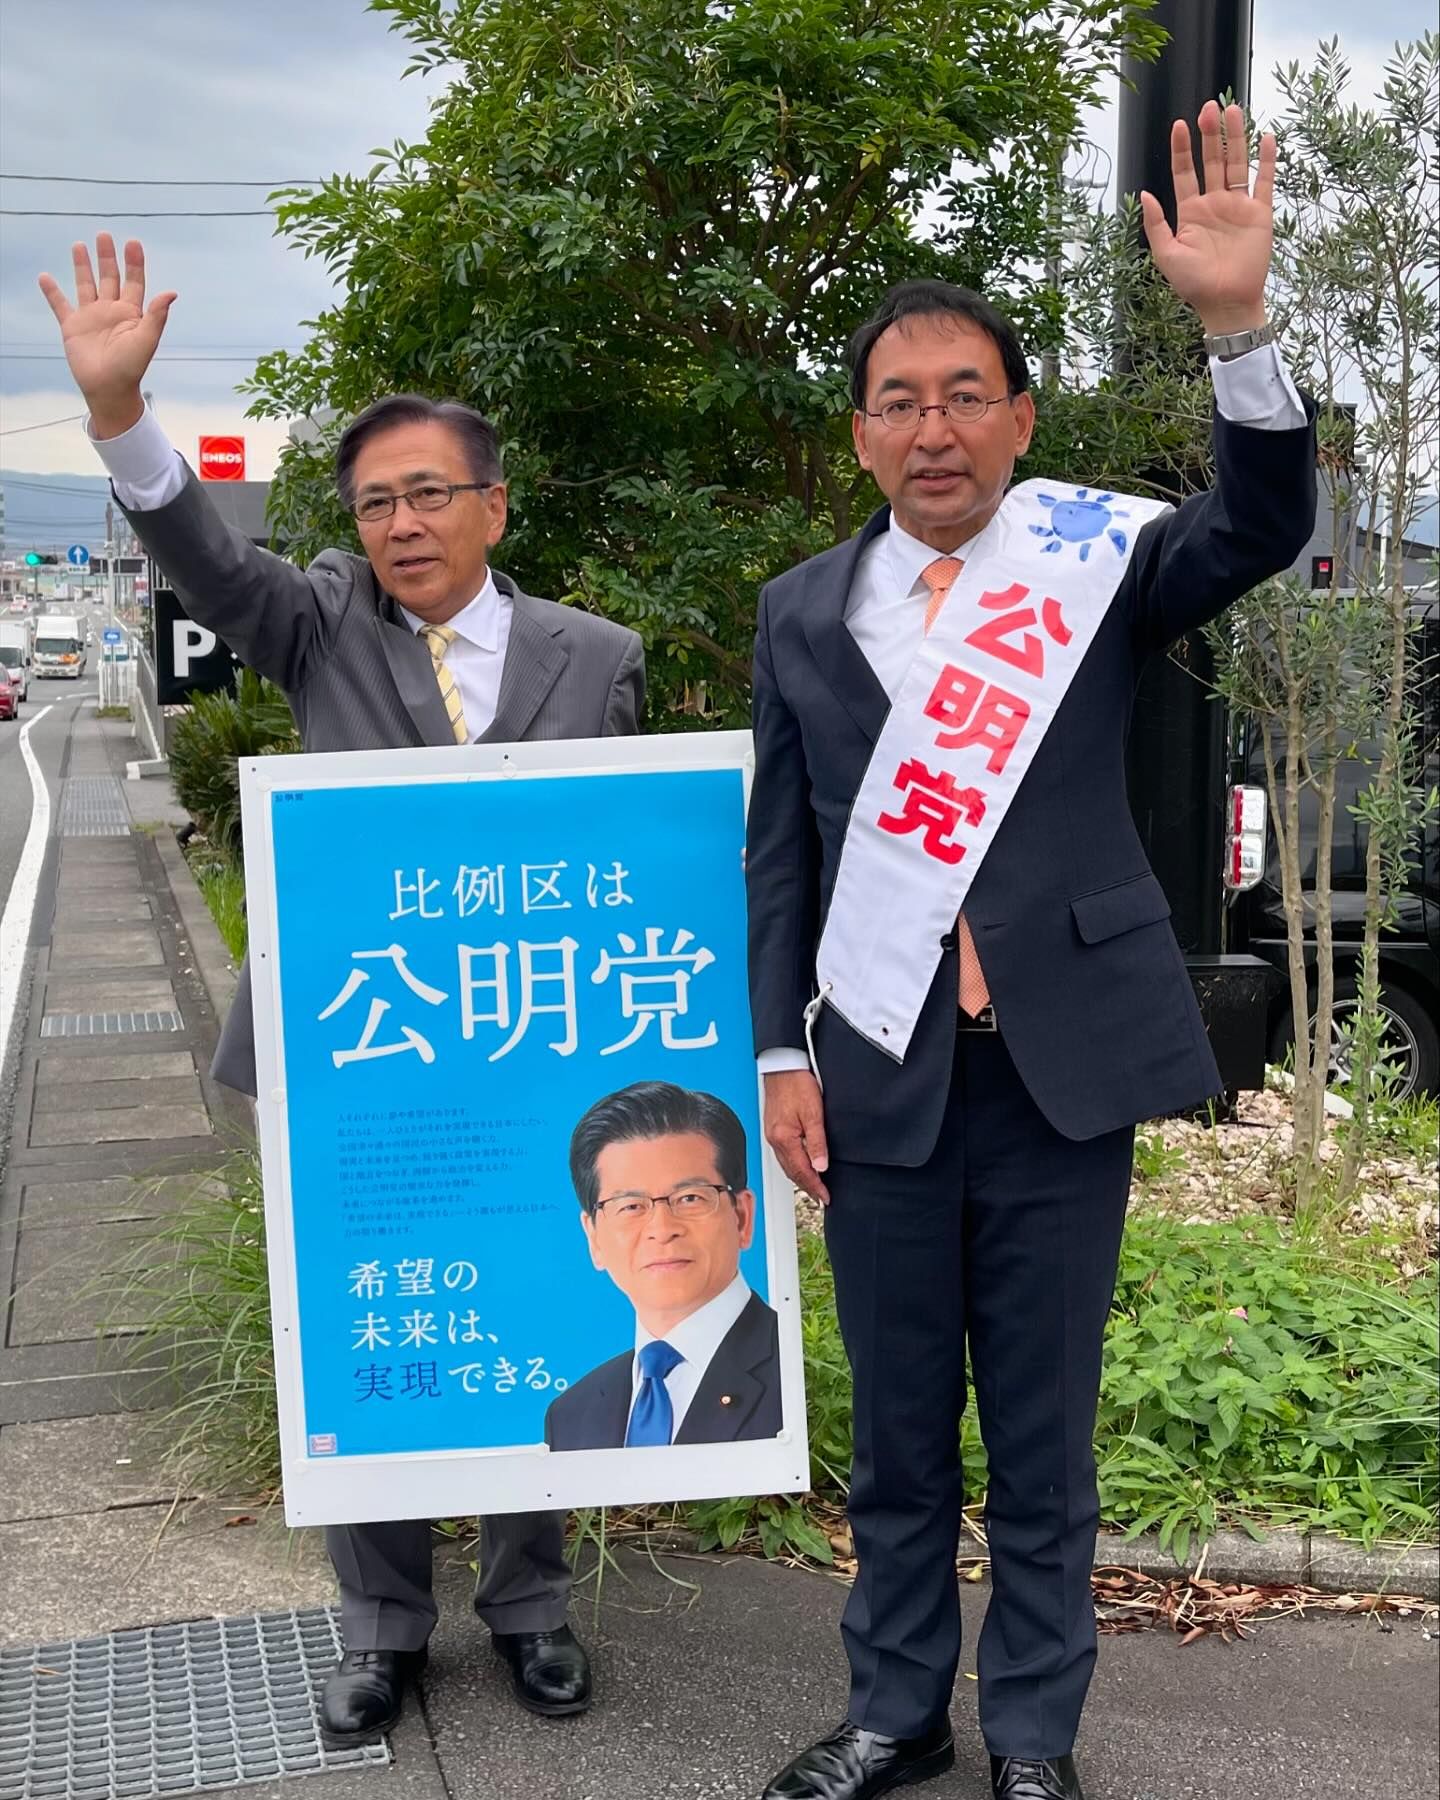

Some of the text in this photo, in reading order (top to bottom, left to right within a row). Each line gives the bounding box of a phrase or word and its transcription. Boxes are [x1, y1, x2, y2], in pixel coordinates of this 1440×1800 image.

[202, 453, 242, 464] ENEOS
[173, 619, 217, 678] P
[877, 582, 1074, 865] 公明党
[388, 860, 634, 921] 比例区は
[317, 927, 719, 1069] 公明党
[347, 1258, 478, 1300] 希望の
[350, 1309, 499, 1351] 未来は、
[353, 1356, 569, 1402] 実現できる。
